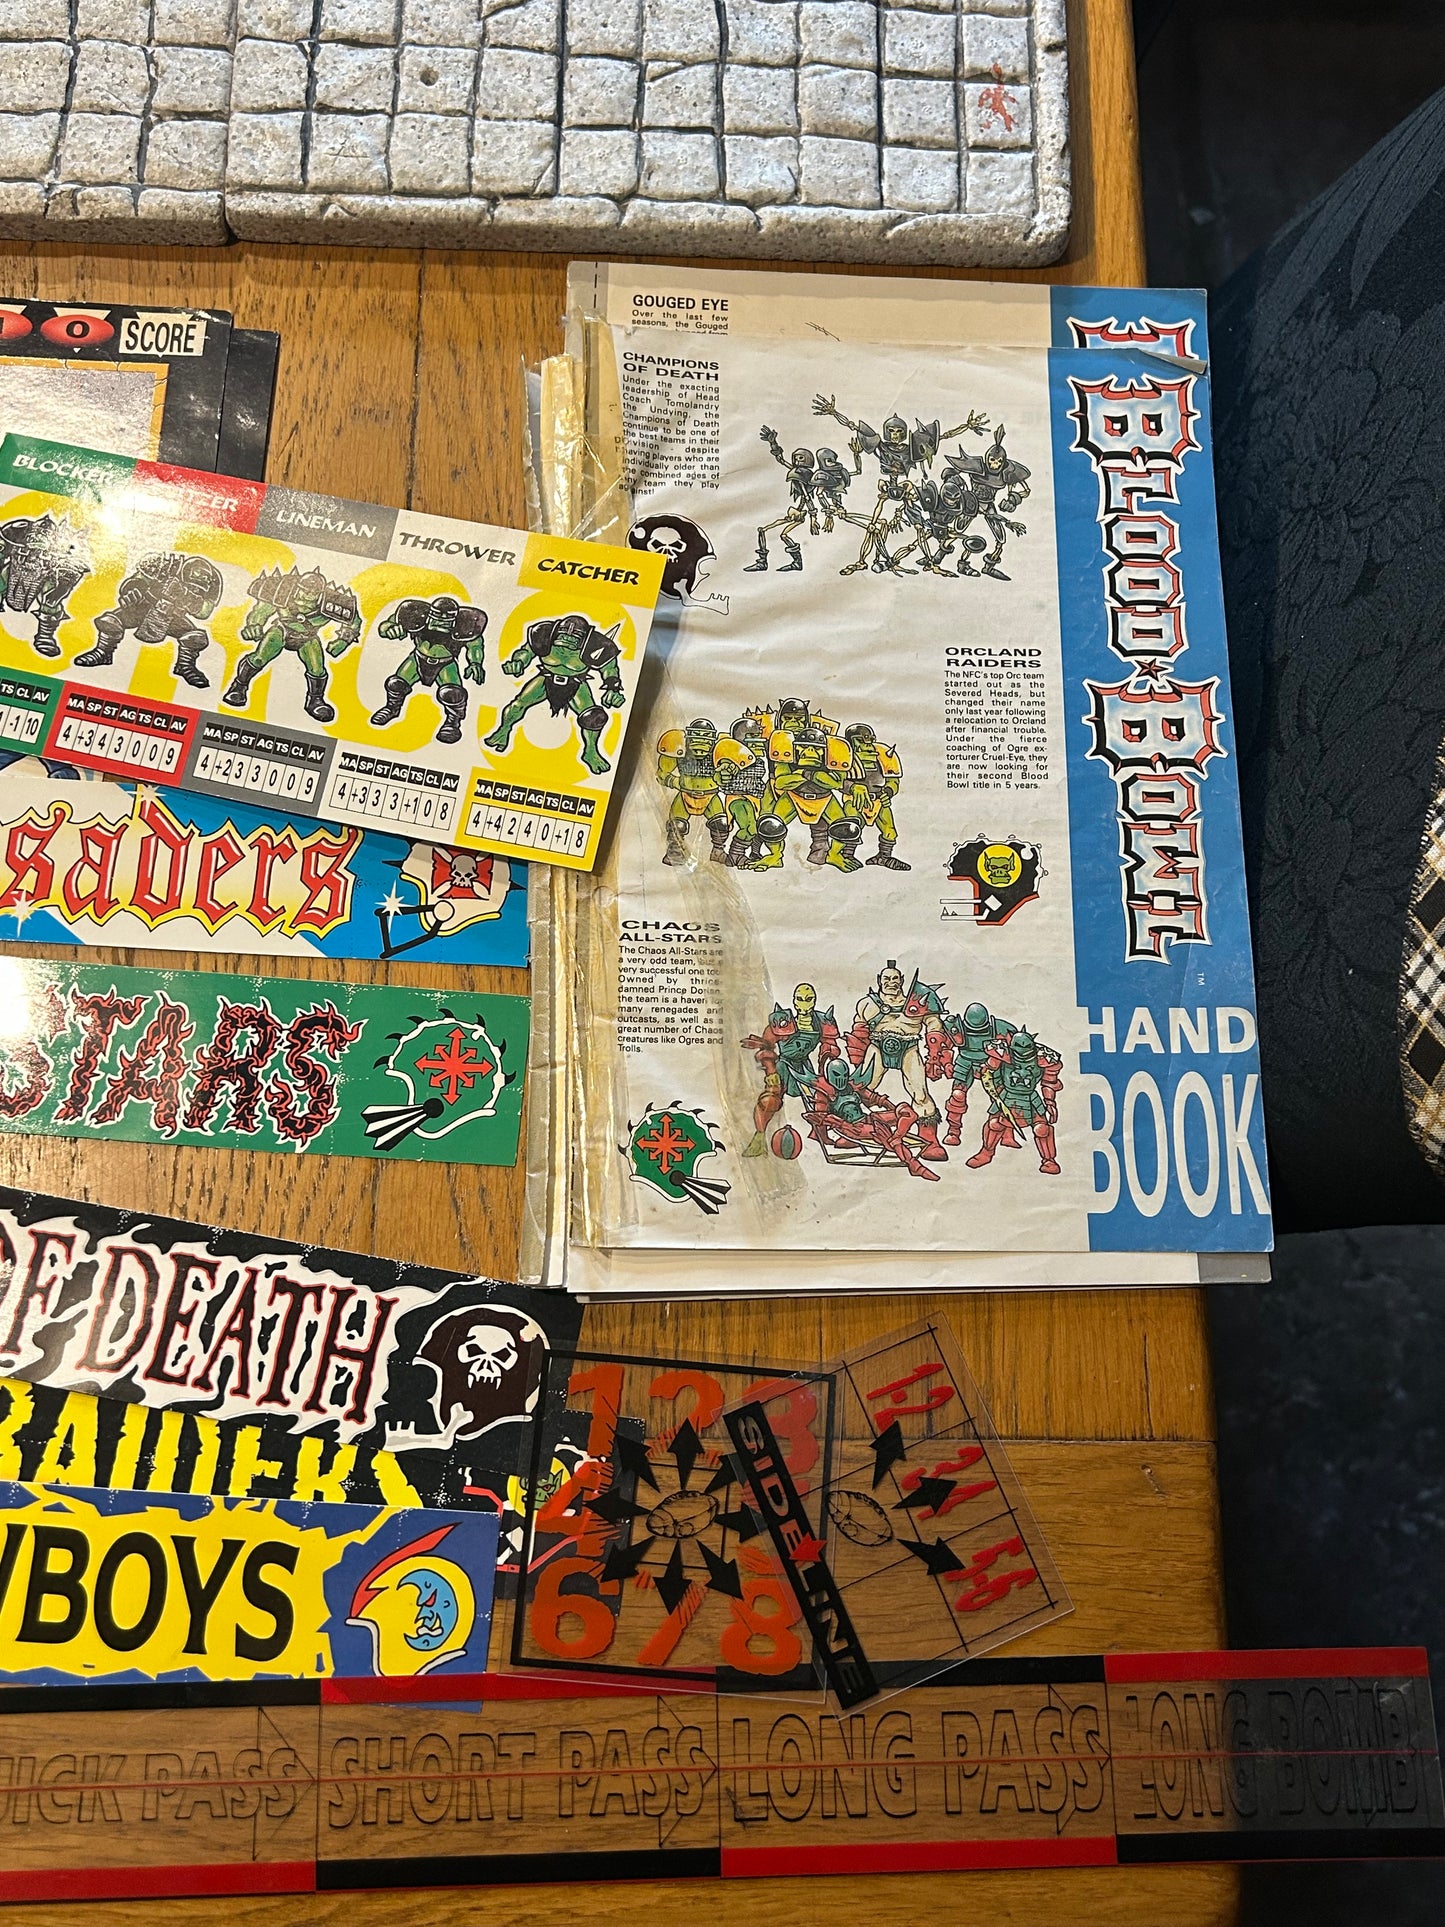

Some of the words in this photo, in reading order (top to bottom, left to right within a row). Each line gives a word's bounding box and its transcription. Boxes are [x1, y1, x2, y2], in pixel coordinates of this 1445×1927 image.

[632, 309, 654, 317] Over
[633, 295, 695, 309] GOUGED
[702, 299, 728, 311] EYE
[125, 320, 196, 353] SCORE
[632, 319, 668, 327] seasons,
[696, 322, 728, 330] Gouged
[623, 352, 719, 370] CHAMPIONS
[624, 363, 648, 373] OF
[656, 368, 718, 381] DEATH
[623, 375, 649, 386] Under
[680, 383, 720, 393] exacting
[623, 384, 669, 398] leadership
[696, 393, 719, 401] Head
[1066, 375, 1202, 662] BLOOD
[276, 510, 377, 539] LINEMAN
[400, 532, 516, 566] THROWER
[537, 558, 640, 585] CATCHER
[945, 647, 1042, 656] ORCLAND
[947, 659, 1041, 668] RAIDERS
[1, 684, 14, 694] TS
[16, 688, 30, 698] CL
[33, 692, 49, 701] AV
[945, 698, 984, 707] changed
[990, 690, 1021, 698] Heads,
[10, 715, 20, 732] -1
[26, 718, 39, 735] 10
[68, 698, 84, 709] MA
[87, 702, 102, 712] SP
[104, 706, 118, 716] ST
[120, 710, 136, 720] AG
[138, 714, 151, 723] TS
[154, 718, 167, 727] CL
[171, 722, 187, 731] AV
[1006, 708, 1046, 717] following
[63, 725, 72, 741] 4
[78, 730, 94, 746] +3
[98, 734, 107, 749] 4
[114, 736, 123, 753] 3
[132, 741, 140, 757] 0
[150, 744, 157, 761] 0
[166, 748, 174, 765] 9
[204, 728, 221, 738] MA
[224, 732, 239, 741] SP
[241, 736, 255, 745] ST
[257, 739, 273, 749] AG
[276, 743, 289, 753] TS
[291, 747, 305, 757] CL
[308, 751, 324, 760] AV
[201, 754, 209, 771] 4
[216, 759, 232, 776] +2
[235, 762, 243, 779] 3
[252, 765, 260, 782] 3
[269, 769, 277, 786] 0
[287, 773, 295, 790] 0
[305, 777, 313, 794] 9
[340, 757, 356, 768] MA
[359, 761, 373, 771] SP
[376, 765, 390, 774] ST
[391, 768, 408, 778] AG
[410, 771, 423, 781] TS
[426, 775, 439, 785] CL
[443, 779, 459, 788] AV
[338, 783, 346, 799] 4
[352, 787, 367, 804] +3
[372, 790, 381, 806] 3
[390, 793, 398, 810] 3
[404, 797, 418, 814] +1
[424, 799, 431, 816] 0
[440, 803, 448, 820] 8
[477, 784, 492, 795] MA
[494, 789, 509, 798] SP
[511, 792, 525, 801] ST
[527, 795, 543, 804] AG
[546, 797, 559, 807] TS
[562, 800, 575, 810] CL
[579, 805, 594, 814] AV
[473, 811, 481, 827] 4
[487, 815, 502, 832] +4
[508, 818, 517, 835] 2
[524, 821, 532, 837] 4
[542, 824, 549, 840] 0
[556, 828, 569, 845] +1
[576, 830, 584, 848] 8
[1081, 676, 1228, 965] BOWL
[619, 933, 722, 943] ALL-STARS
[622, 921, 720, 932] CHAOS
[619, 946, 635, 954] The
[638, 946, 666, 954] Chaos
[669, 947, 707, 956] All-Stars
[1197, 973, 1205, 985] TM
[1077, 1007, 1256, 1053] HAND
[1080, 1071, 1271, 1218] BOOK
[75, 1244, 400, 1426] DEATH
[568, 1365, 624, 1457] 1
[646, 1371, 725, 1465] 2
[531, 1557, 619, 1658] 6
[721, 1578, 803, 1676] 8
[732, 1712, 916, 1822] LONG
[941, 1705, 1103, 1815] PASS
[1125, 1690, 1259, 1820] LONG
[1267, 1686, 1419, 1816] BOMB
[142, 1747, 298, 1822] PASS
[328, 1731, 537, 1828] SHORT
[557, 1725, 704, 1818] PASS
